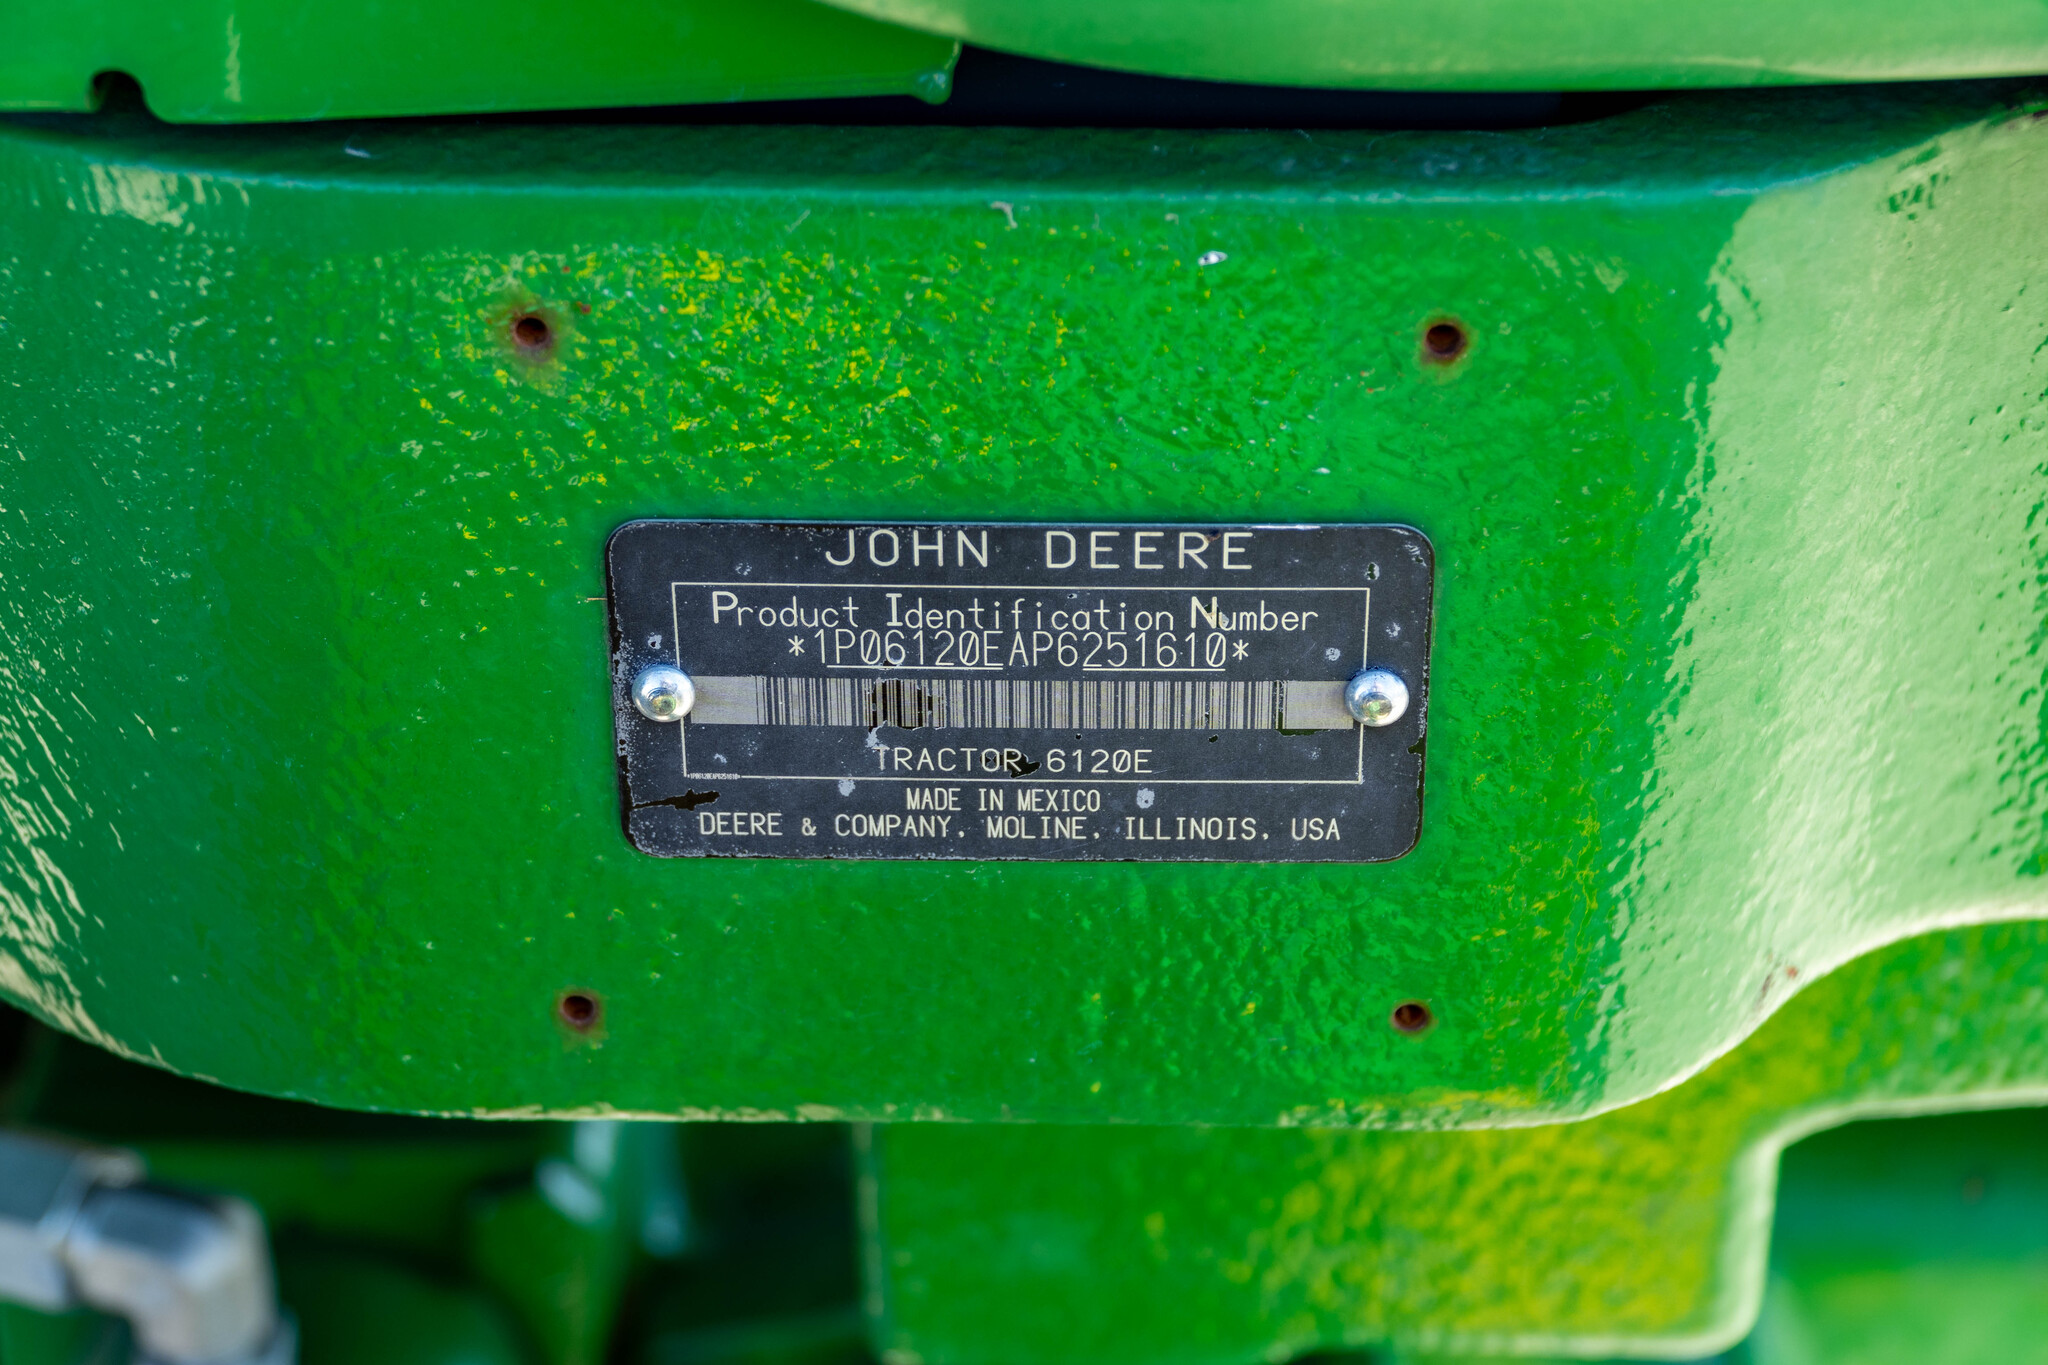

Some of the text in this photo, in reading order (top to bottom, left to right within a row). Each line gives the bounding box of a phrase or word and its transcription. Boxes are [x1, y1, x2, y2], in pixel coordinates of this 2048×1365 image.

[825, 529, 1254, 569] JOHN DEERE
[711, 591, 1319, 631] Product Identification Number
[873, 747, 1153, 773] TRACTOR 6120E
[906, 788, 1101, 812] MADE IN MEXICO
[699, 812, 1341, 841] DEERE & COMPANY, MOLINE, ILLINOIS, USA
